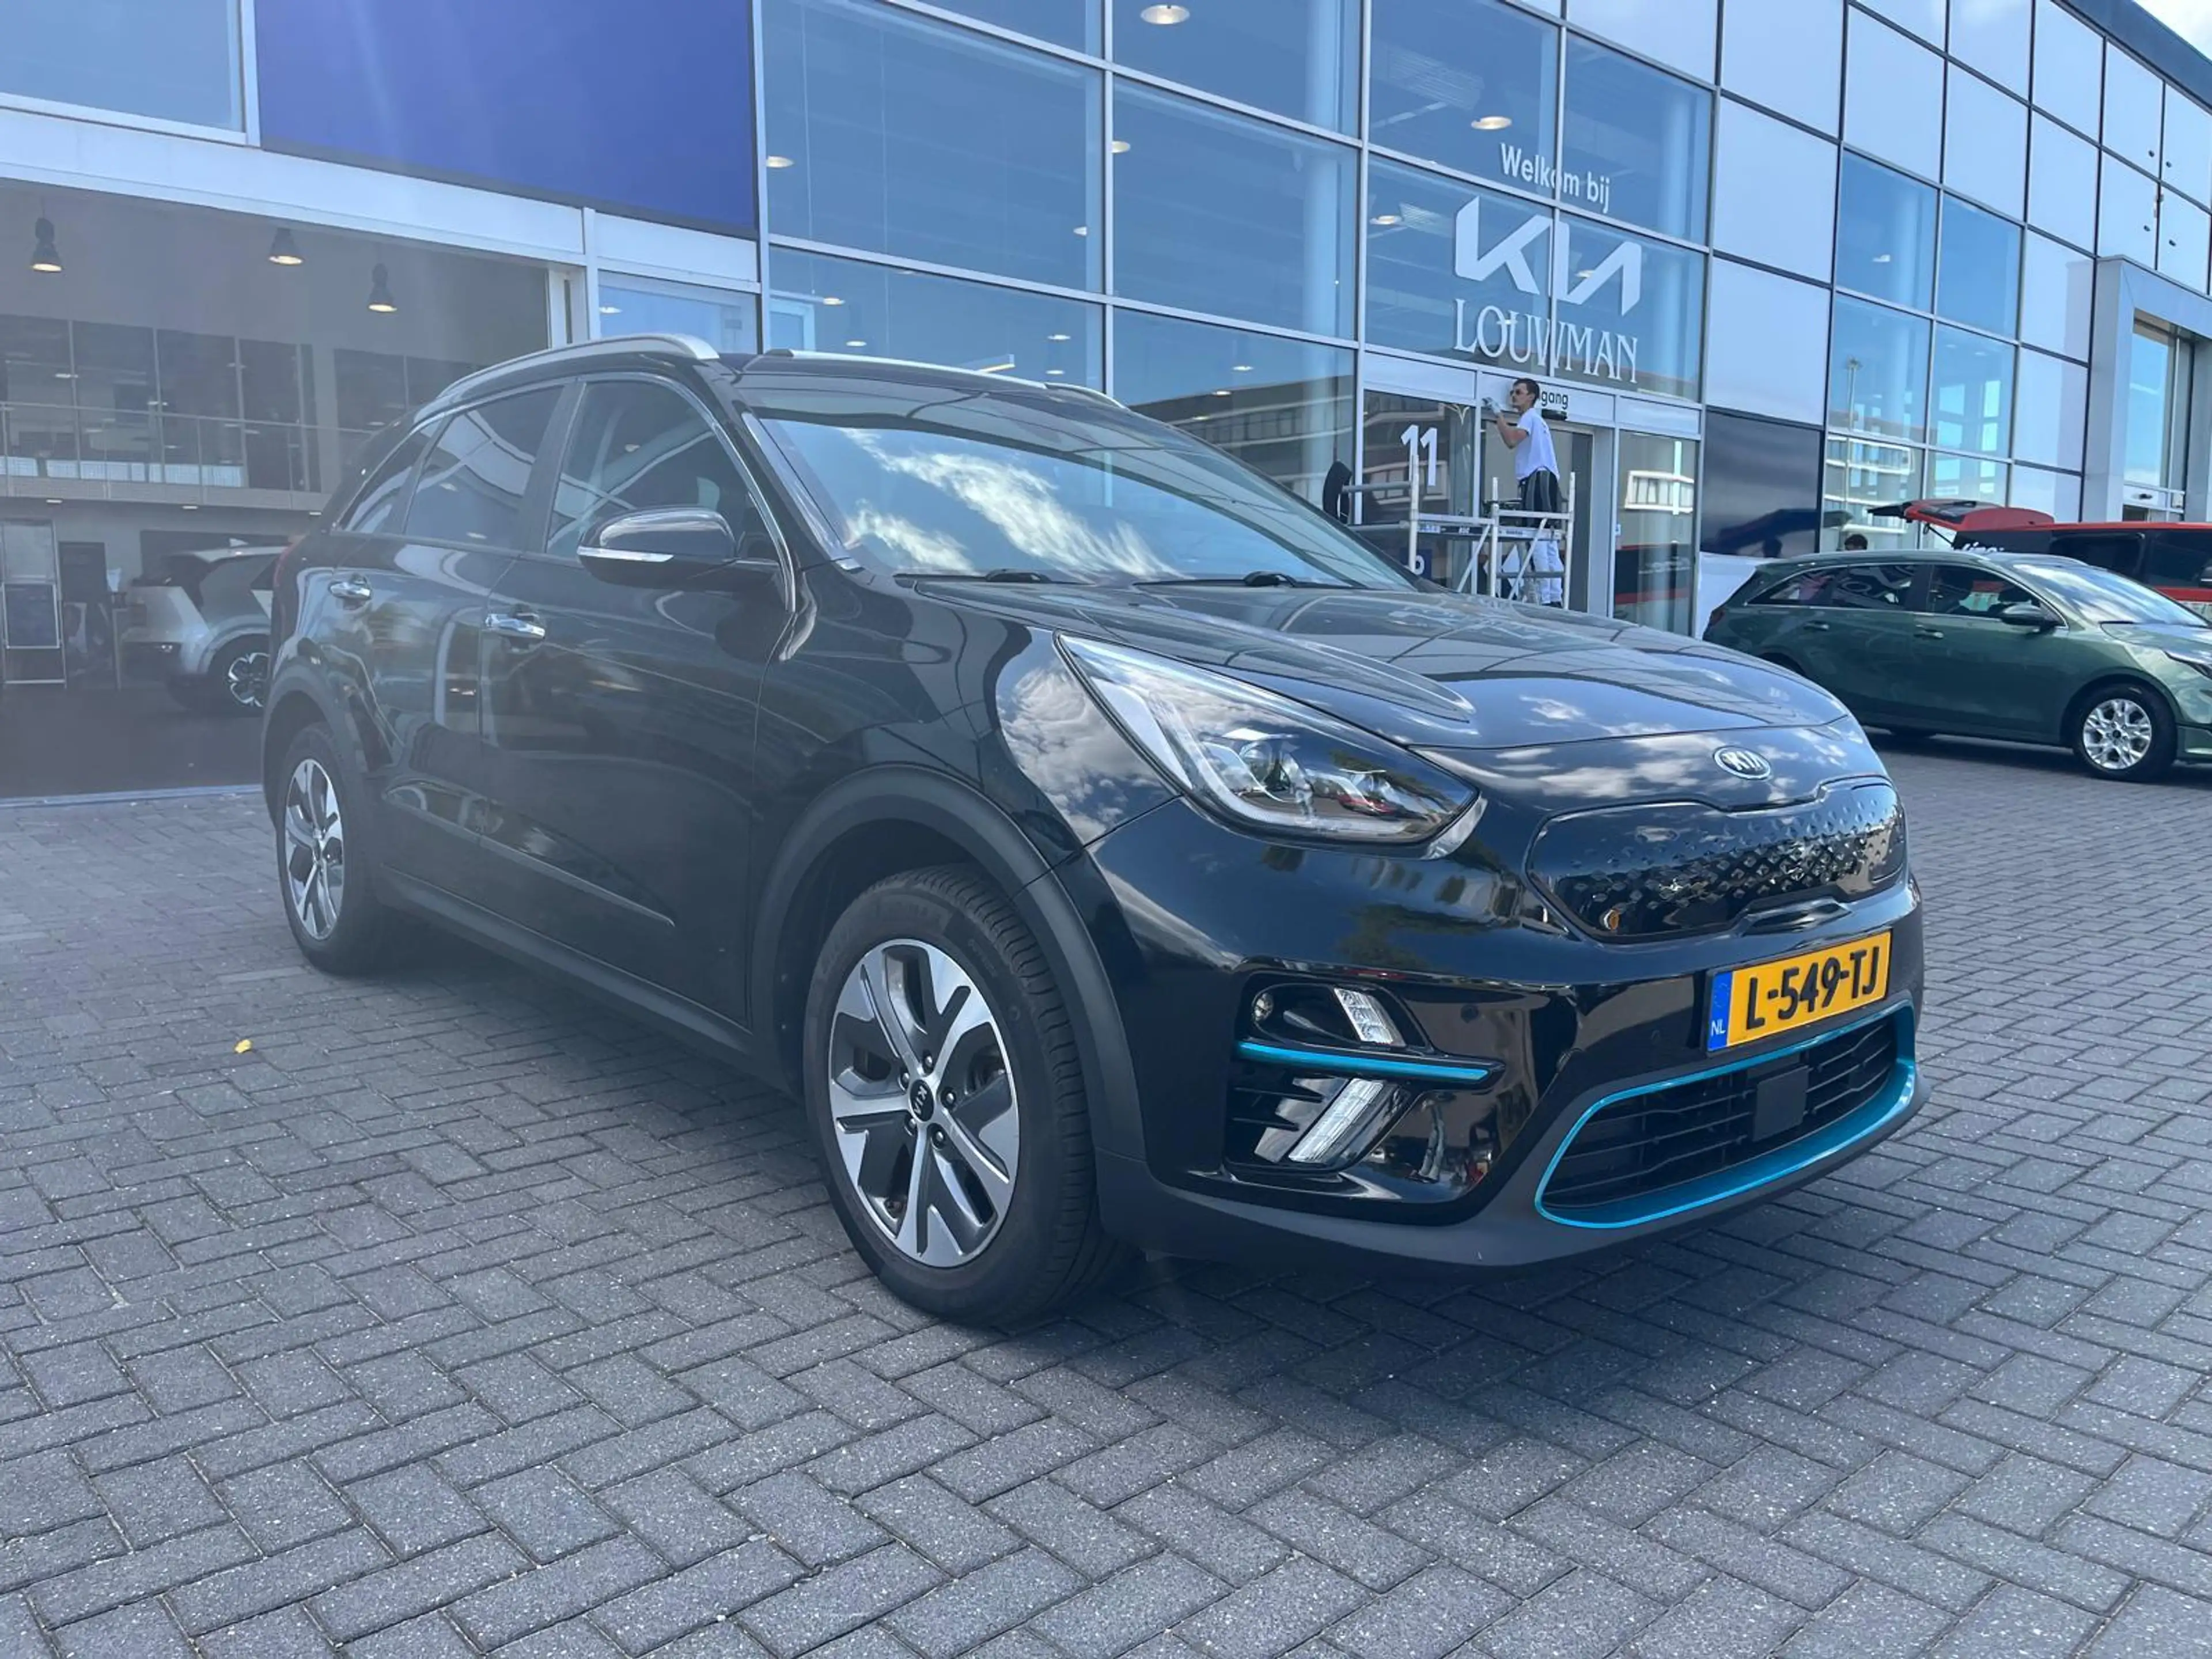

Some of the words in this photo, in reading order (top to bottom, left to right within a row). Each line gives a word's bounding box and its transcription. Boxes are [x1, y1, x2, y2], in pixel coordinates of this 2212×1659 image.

[1587, 171, 1611, 214] bij
[1453, 298, 1638, 384] LOUWMAN
[1541, 391, 1568, 410] gang
[1400, 425, 1437, 486] 11
[1746, 946, 1880, 1030] L-549-TJ
[1710, 1018, 1726, 1037] NL
[913, 1085, 927, 1114] KIA
